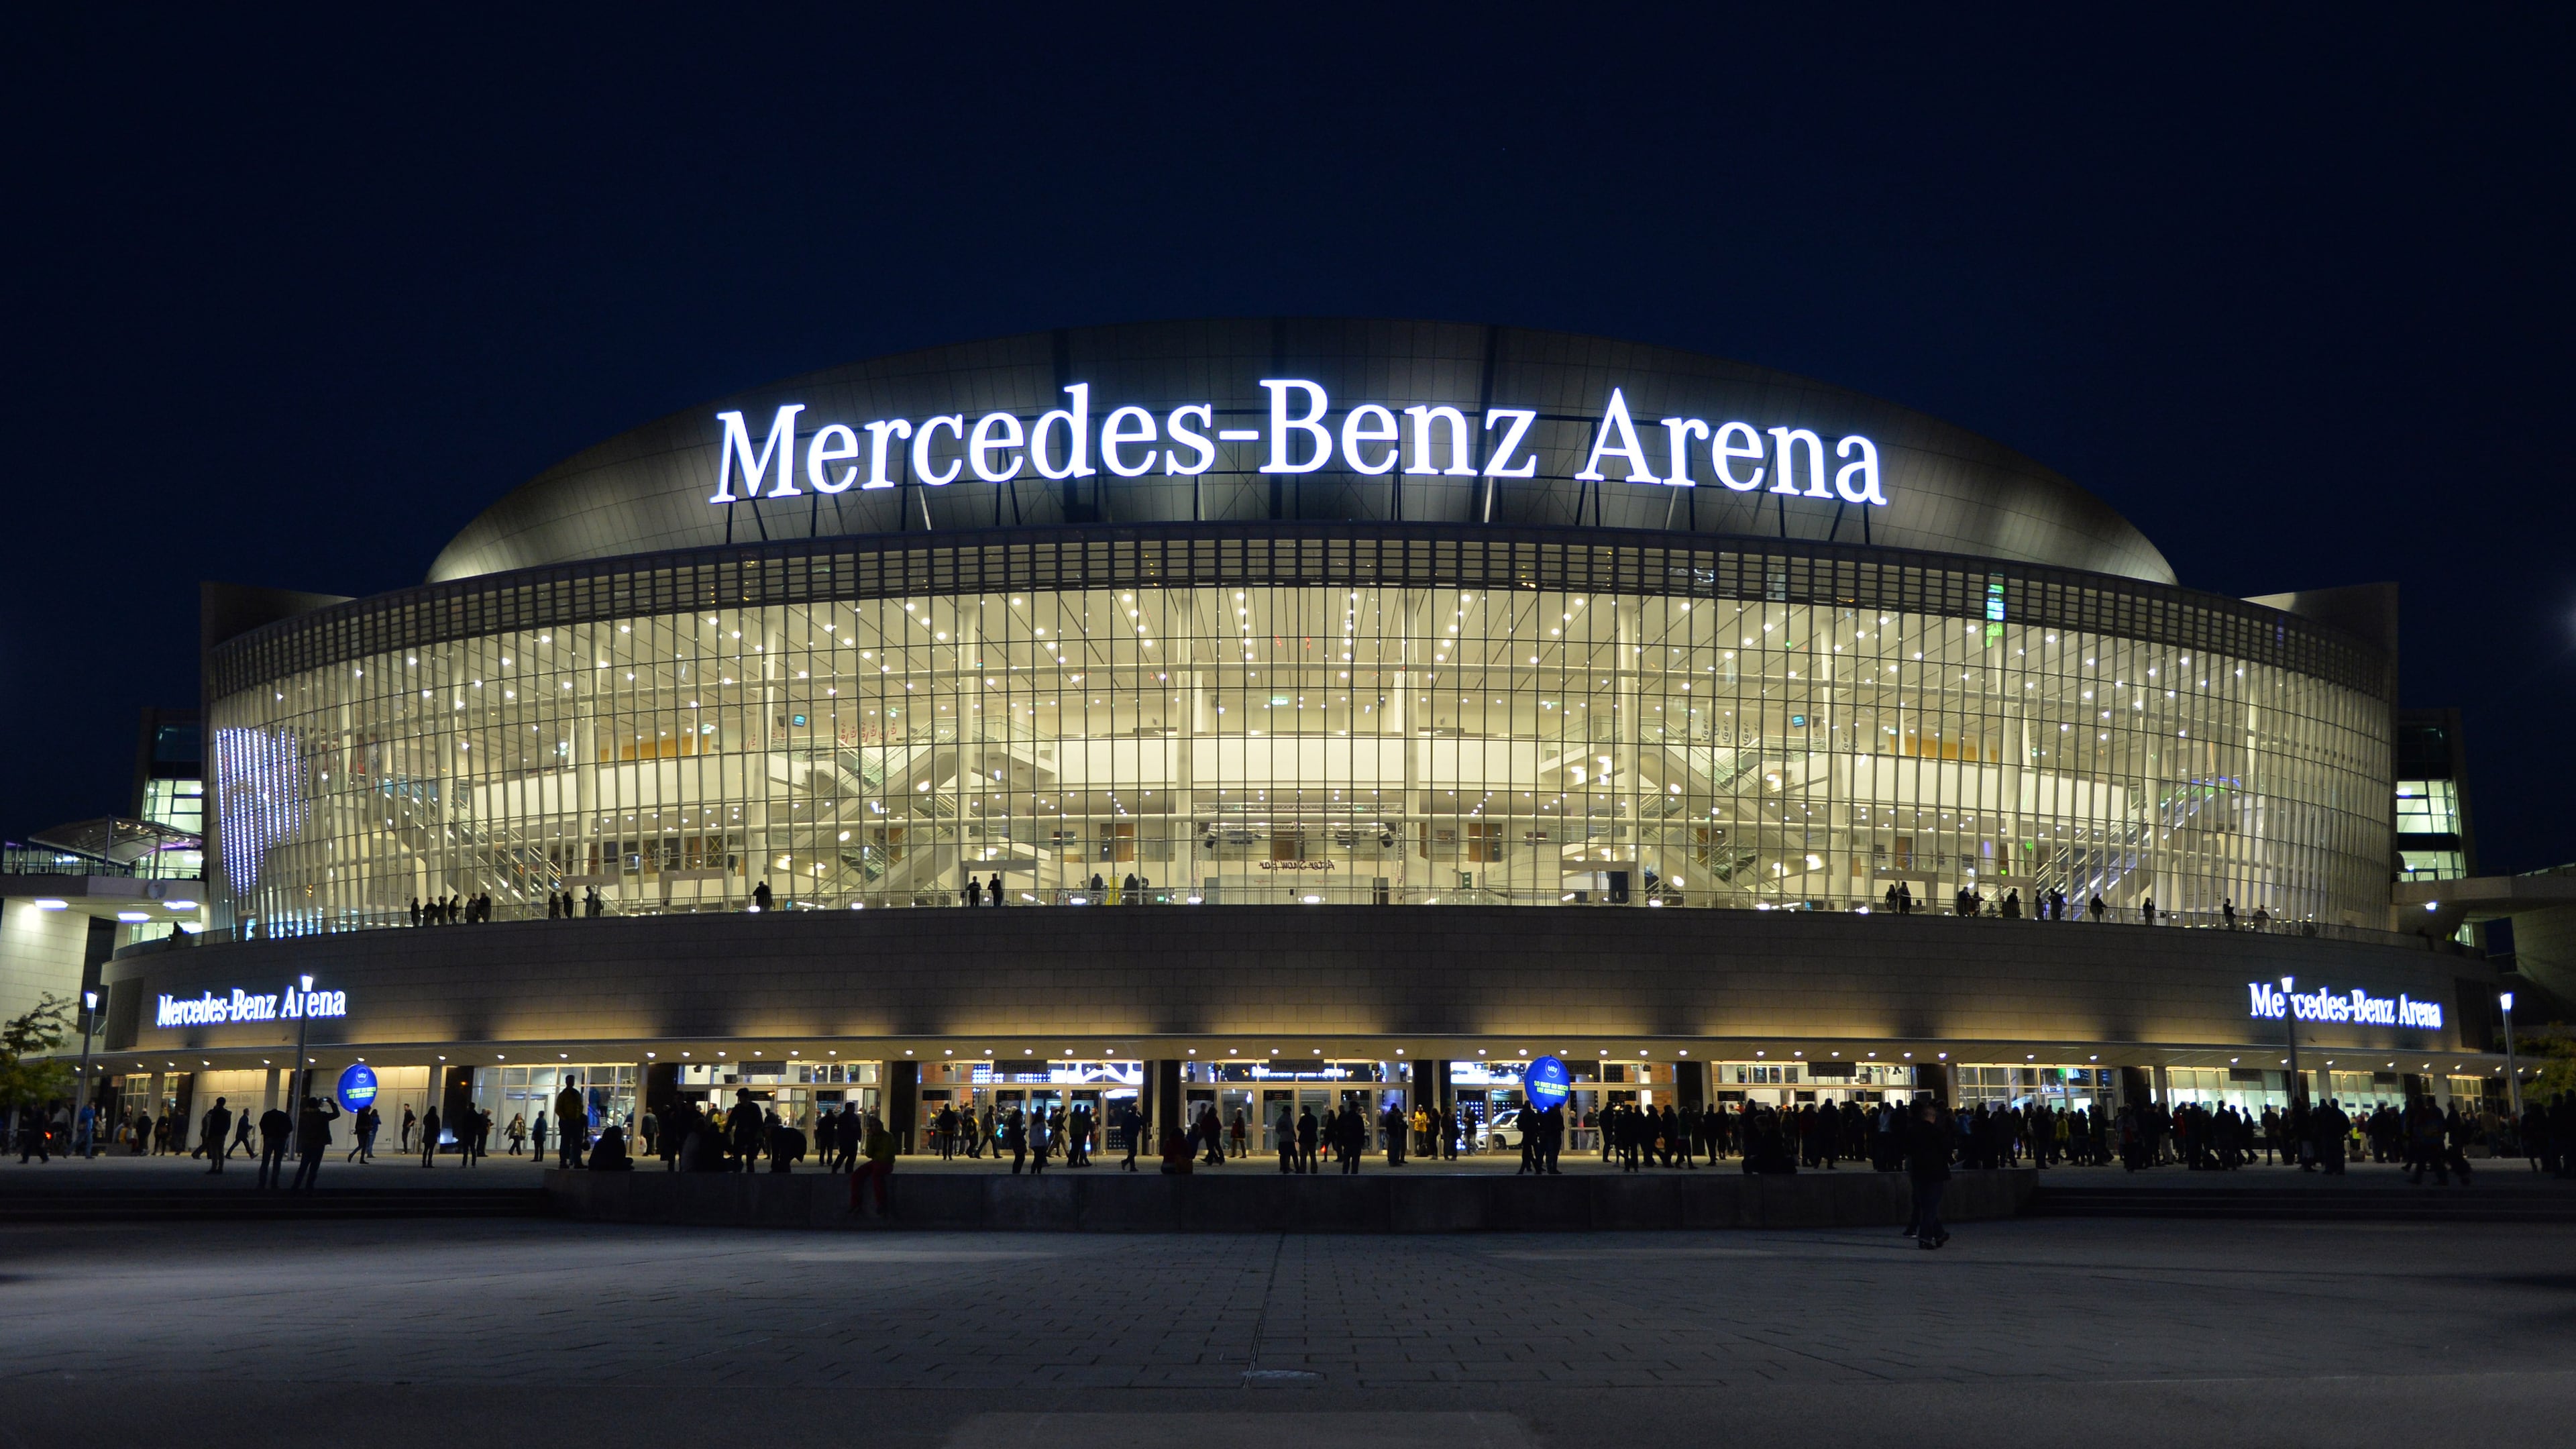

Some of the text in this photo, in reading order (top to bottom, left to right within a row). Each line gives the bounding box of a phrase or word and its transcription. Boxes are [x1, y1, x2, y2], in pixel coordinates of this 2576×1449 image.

[708, 378, 1888, 506] Mercedes-Benz Arena
[156, 987, 278, 1026] Mercedes-Benz
[2248, 982, 2443, 1028] Mecedes-Benz Arena
[746, 1063, 779, 1075] Eingang
[1003, 1062, 1039, 1073] Eingang
[1816, 1065, 1849, 1076] Eingang
